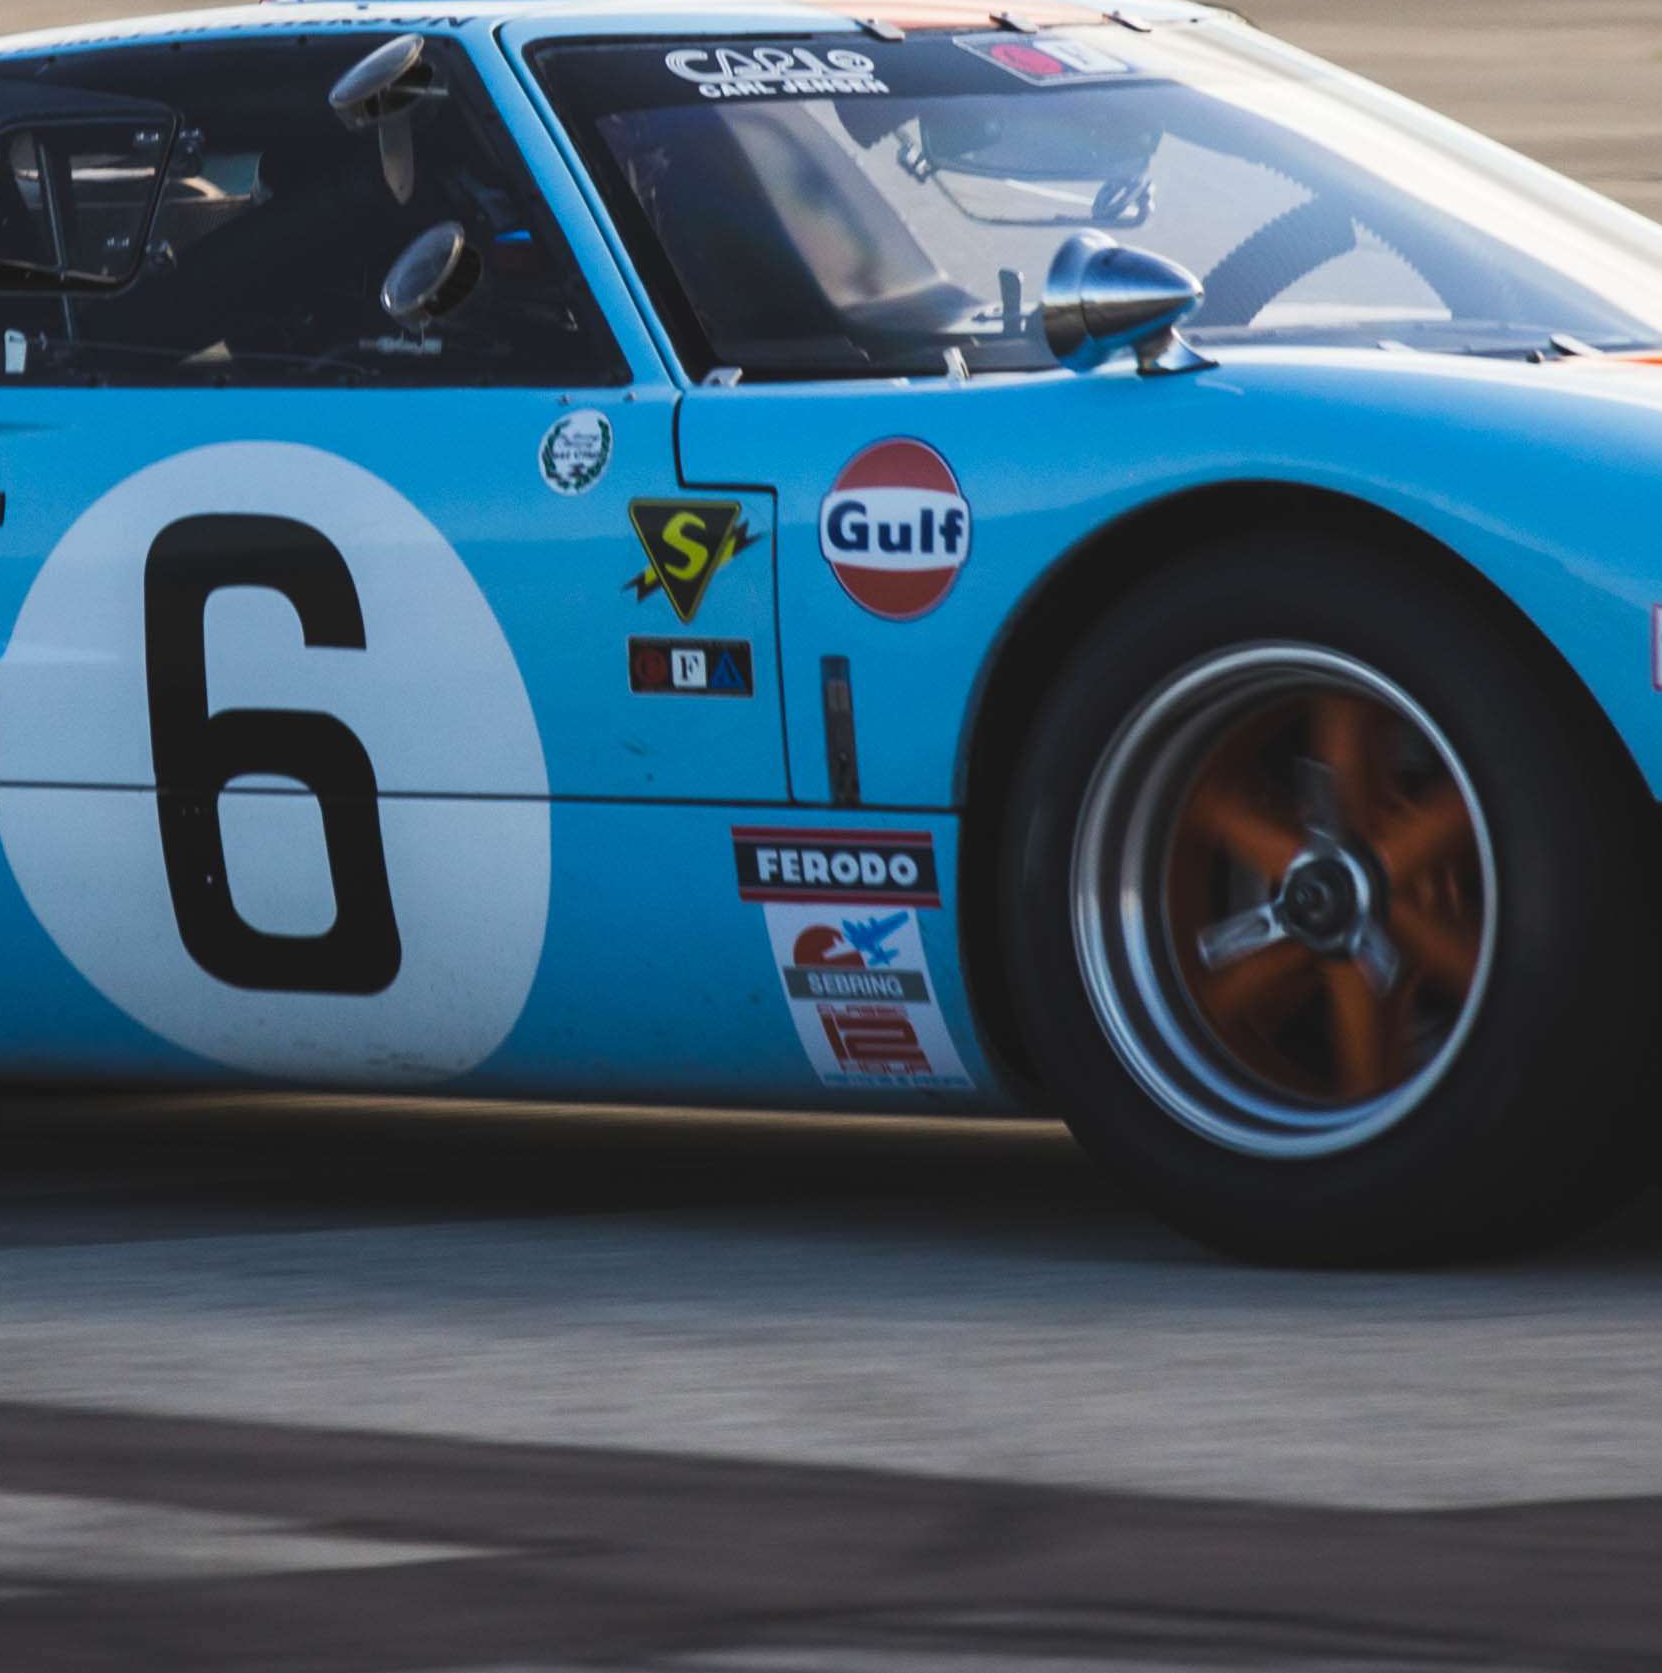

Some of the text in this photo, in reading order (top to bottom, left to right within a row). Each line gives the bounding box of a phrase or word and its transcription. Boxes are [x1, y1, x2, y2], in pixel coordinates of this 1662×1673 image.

[697, 77, 890, 98] CARL JENSEN
[826, 500, 965, 555] Gulf
[144, 512, 402, 997] 6
[755, 848, 919, 887] FERODO
[808, 971, 904, 999] SEBRING
